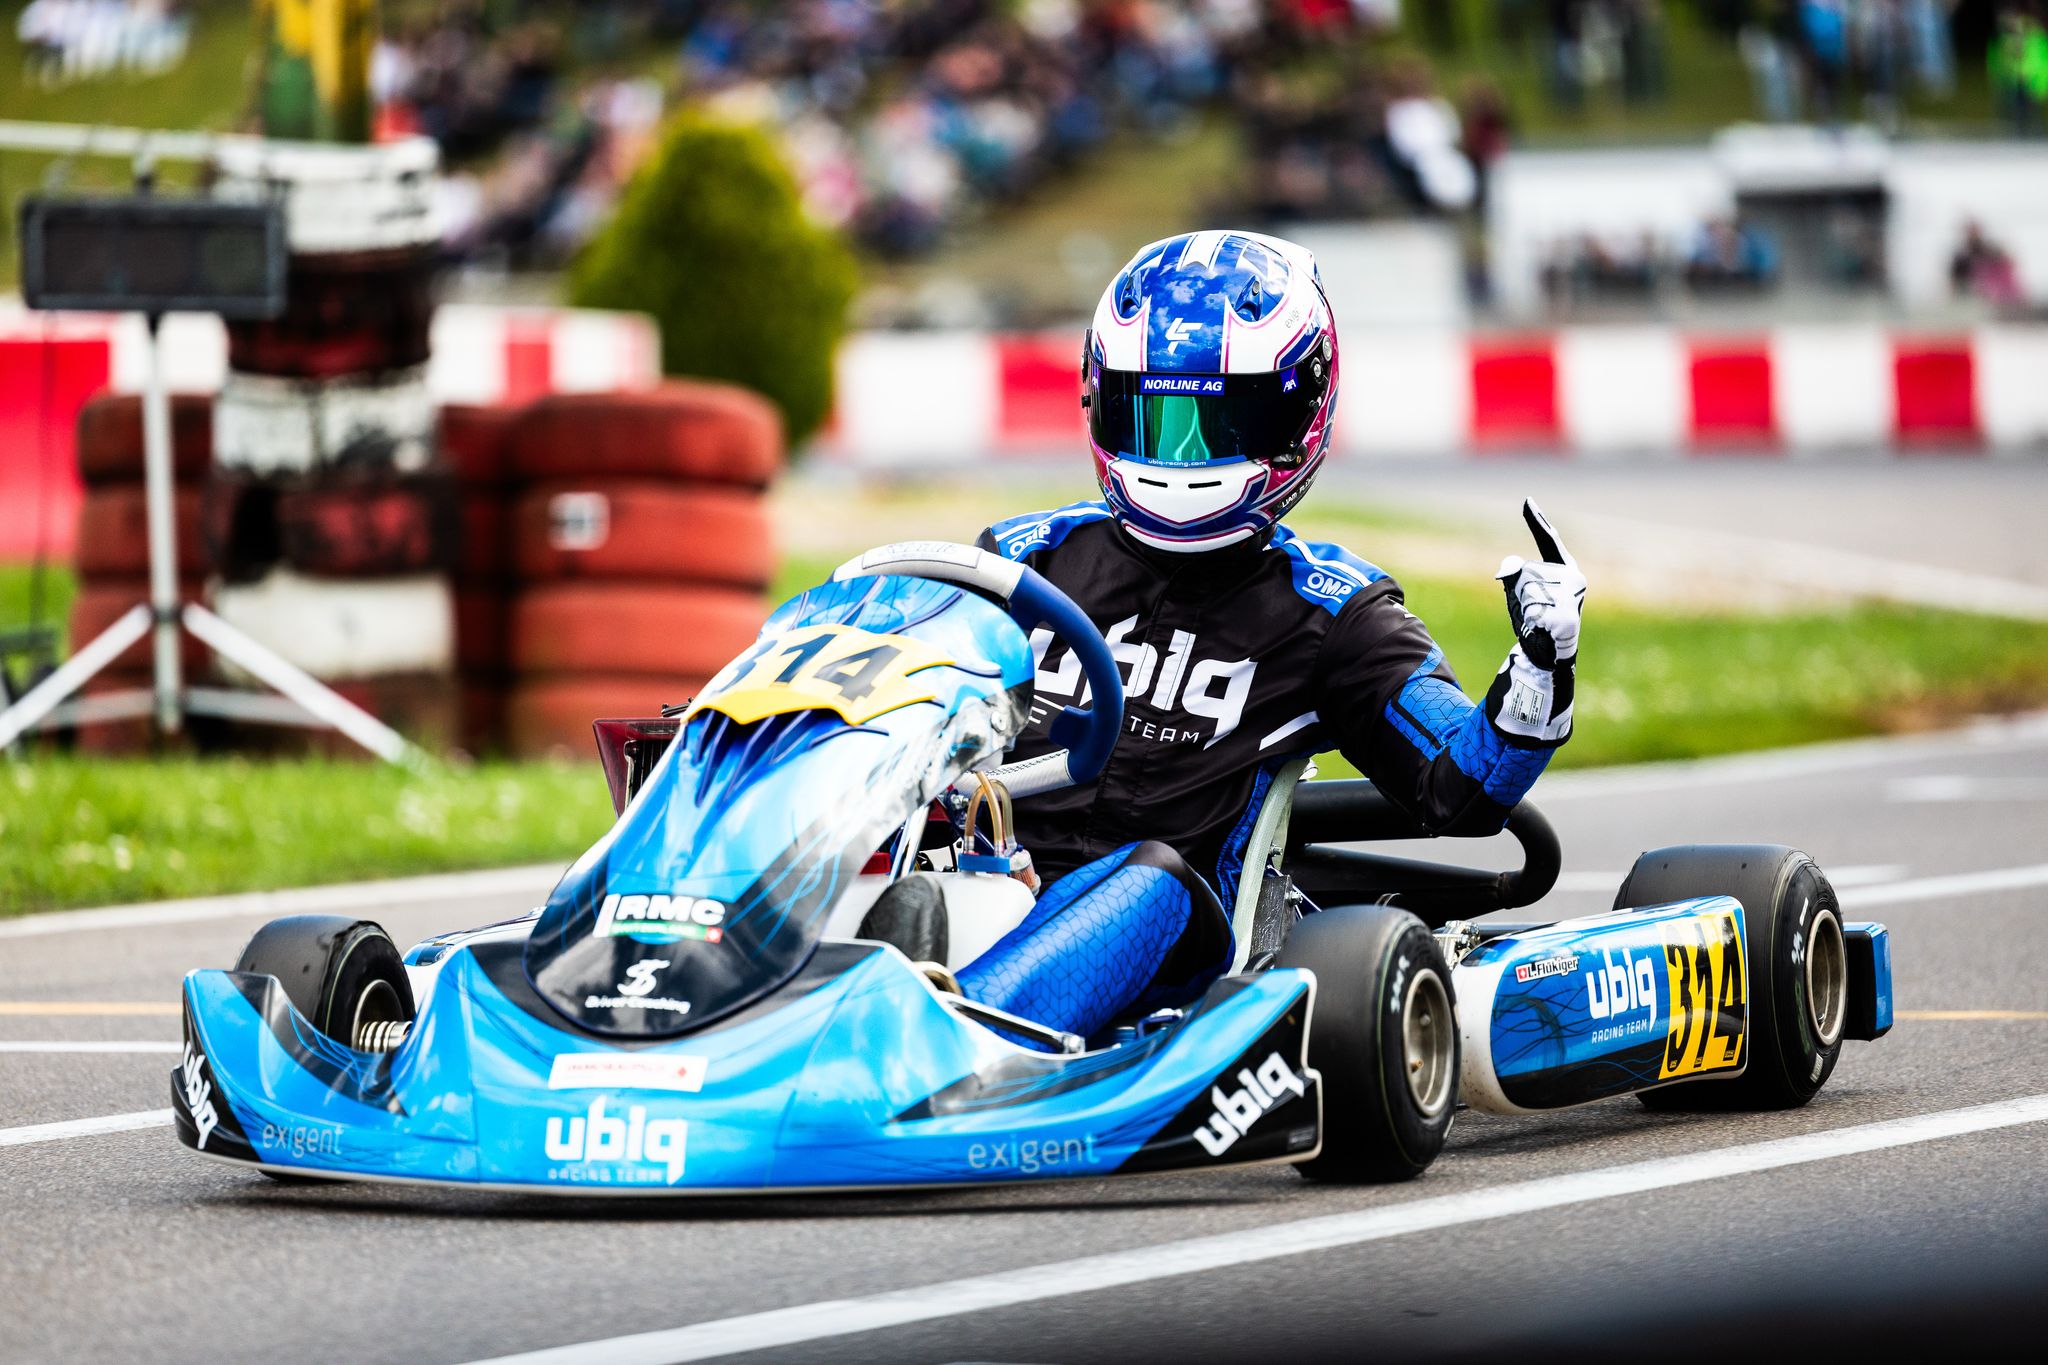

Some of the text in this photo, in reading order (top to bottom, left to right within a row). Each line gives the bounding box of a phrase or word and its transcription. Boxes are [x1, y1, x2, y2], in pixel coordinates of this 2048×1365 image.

[1144, 379, 1223, 391] NORLINE AG
[1148, 459, 1207, 467] ubiq-racing.com
[1306, 572, 1353, 597] OMP
[713, 633, 902, 701] 314
[1130, 715, 1200, 743] TEAM
[1667, 916, 1745, 1072] 314
[1592, 1019, 1648, 1044] RACING TEAM
[262, 1118, 344, 1158] exigent
[968, 1133, 1100, 1172] exigent
